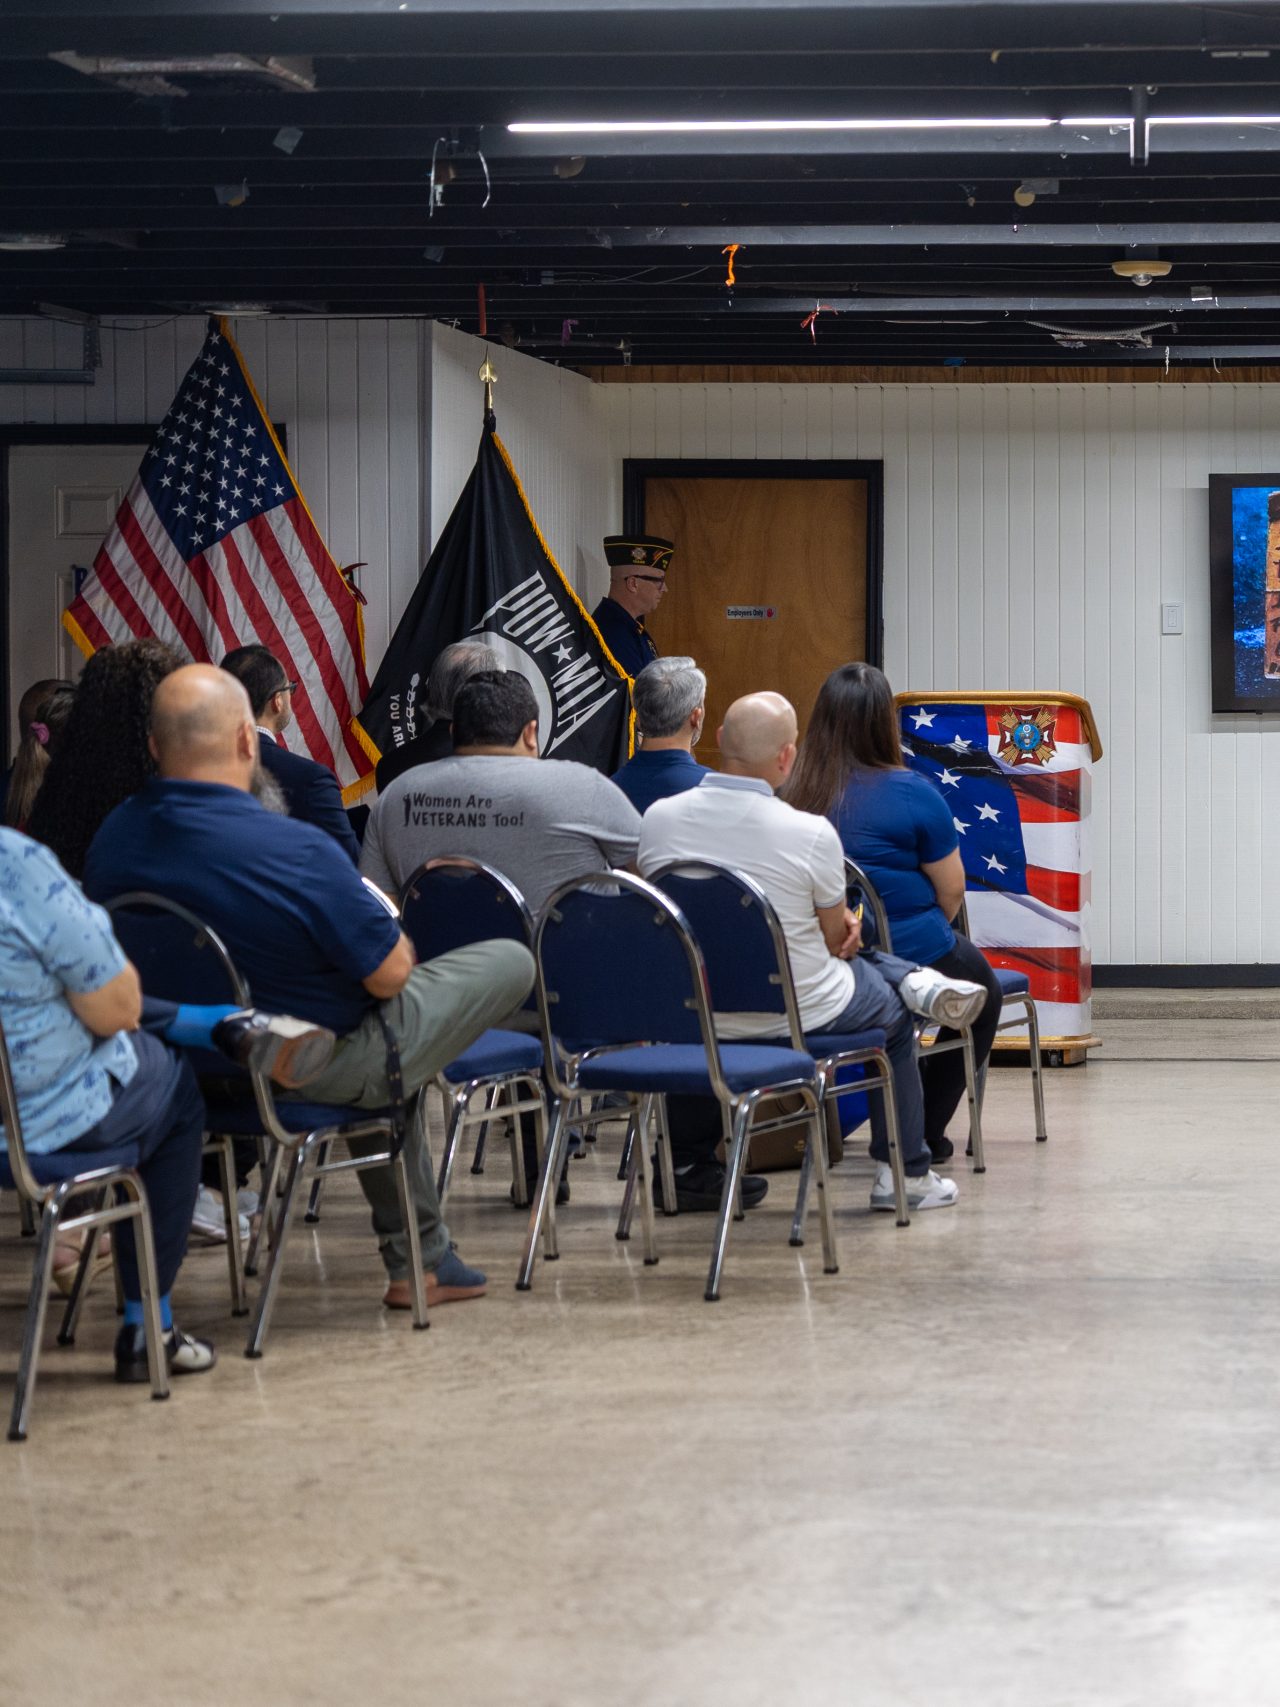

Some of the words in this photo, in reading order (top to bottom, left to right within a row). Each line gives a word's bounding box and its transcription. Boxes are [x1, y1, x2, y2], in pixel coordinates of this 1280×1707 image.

[753, 609, 764, 617] Only
[390, 694, 400, 719] YOU
[413, 792, 461, 808] Women
[466, 794, 492, 809] Are
[412, 812, 487, 827] VETERANS
[492, 811, 524, 827] Too!
